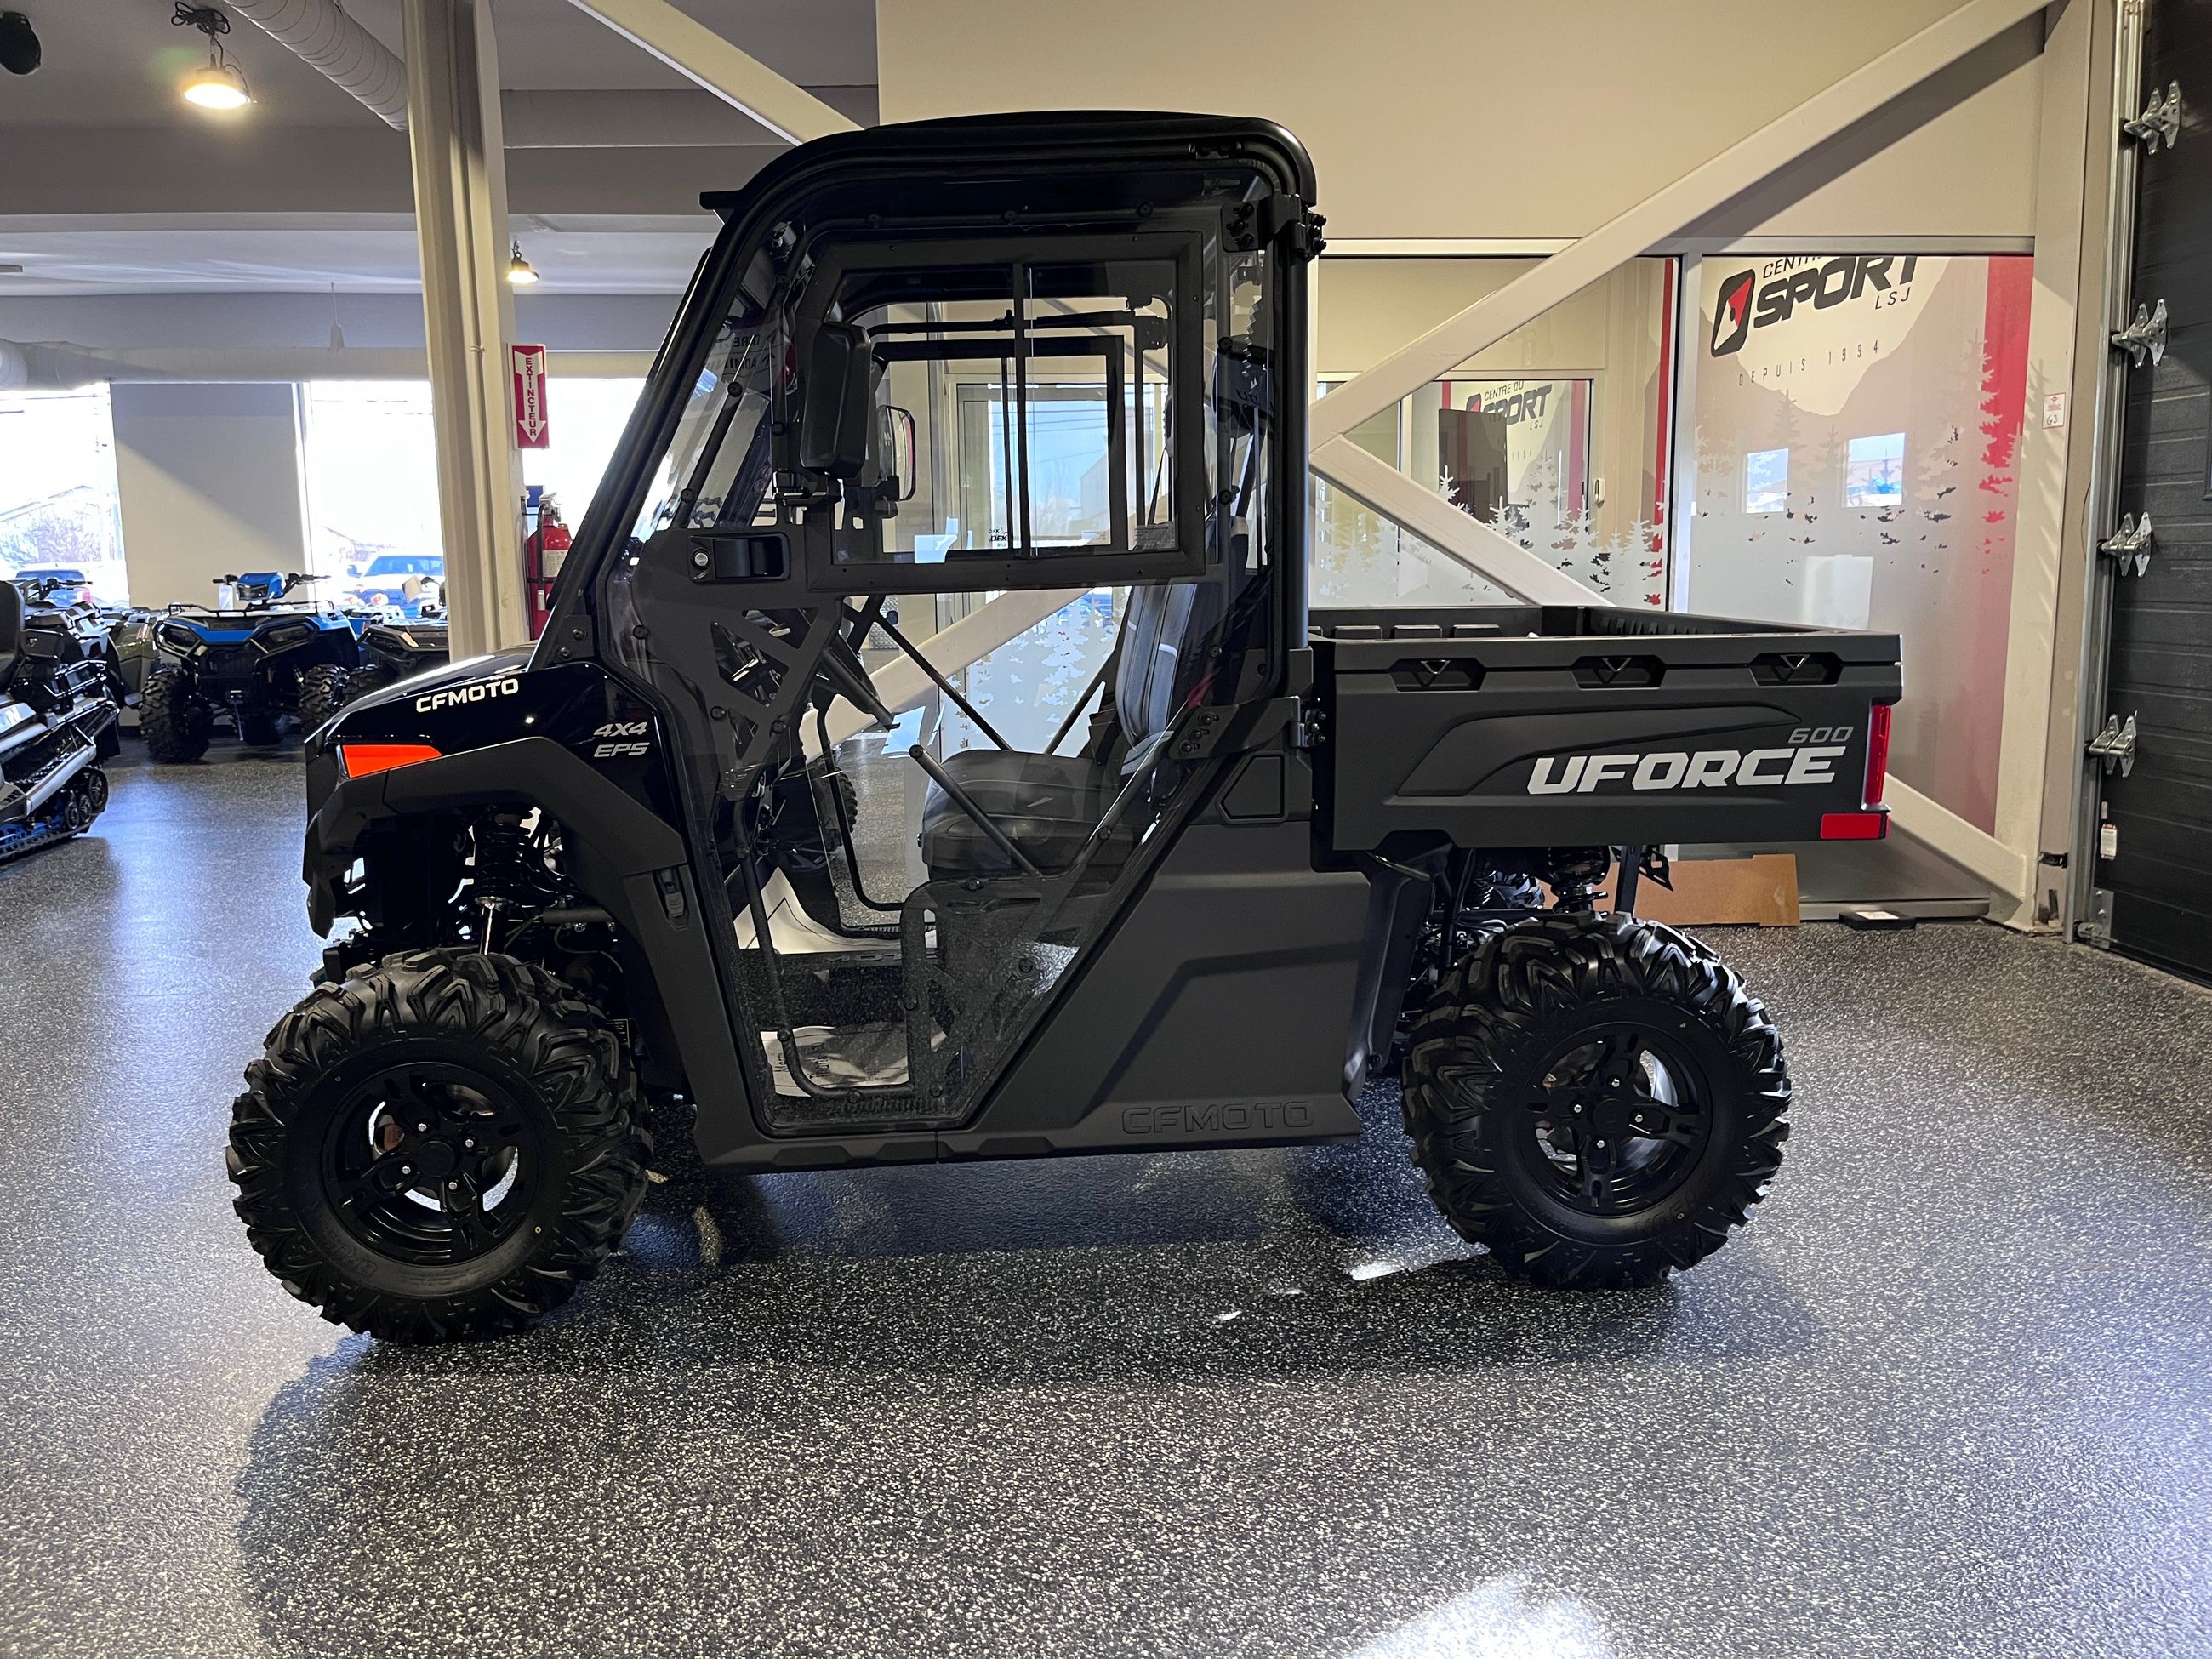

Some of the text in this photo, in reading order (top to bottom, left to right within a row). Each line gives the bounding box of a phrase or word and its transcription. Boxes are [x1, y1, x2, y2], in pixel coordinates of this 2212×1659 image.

[1874, 286, 1912, 311] LSJ
[1738, 339, 1878, 386] DEPUIS 1994
[525, 357, 537, 436] EXTINCTEUR
[1484, 383, 1512, 402] CENTRE
[416, 678, 519, 713] CFMOTO
[593, 721, 647, 738] 4X4
[1787, 727, 1854, 744] 600
[593, 742, 650, 758] EPS
[1526, 745, 1846, 795] UFORCE
[1122, 1101, 1314, 1135] CFMOTO
